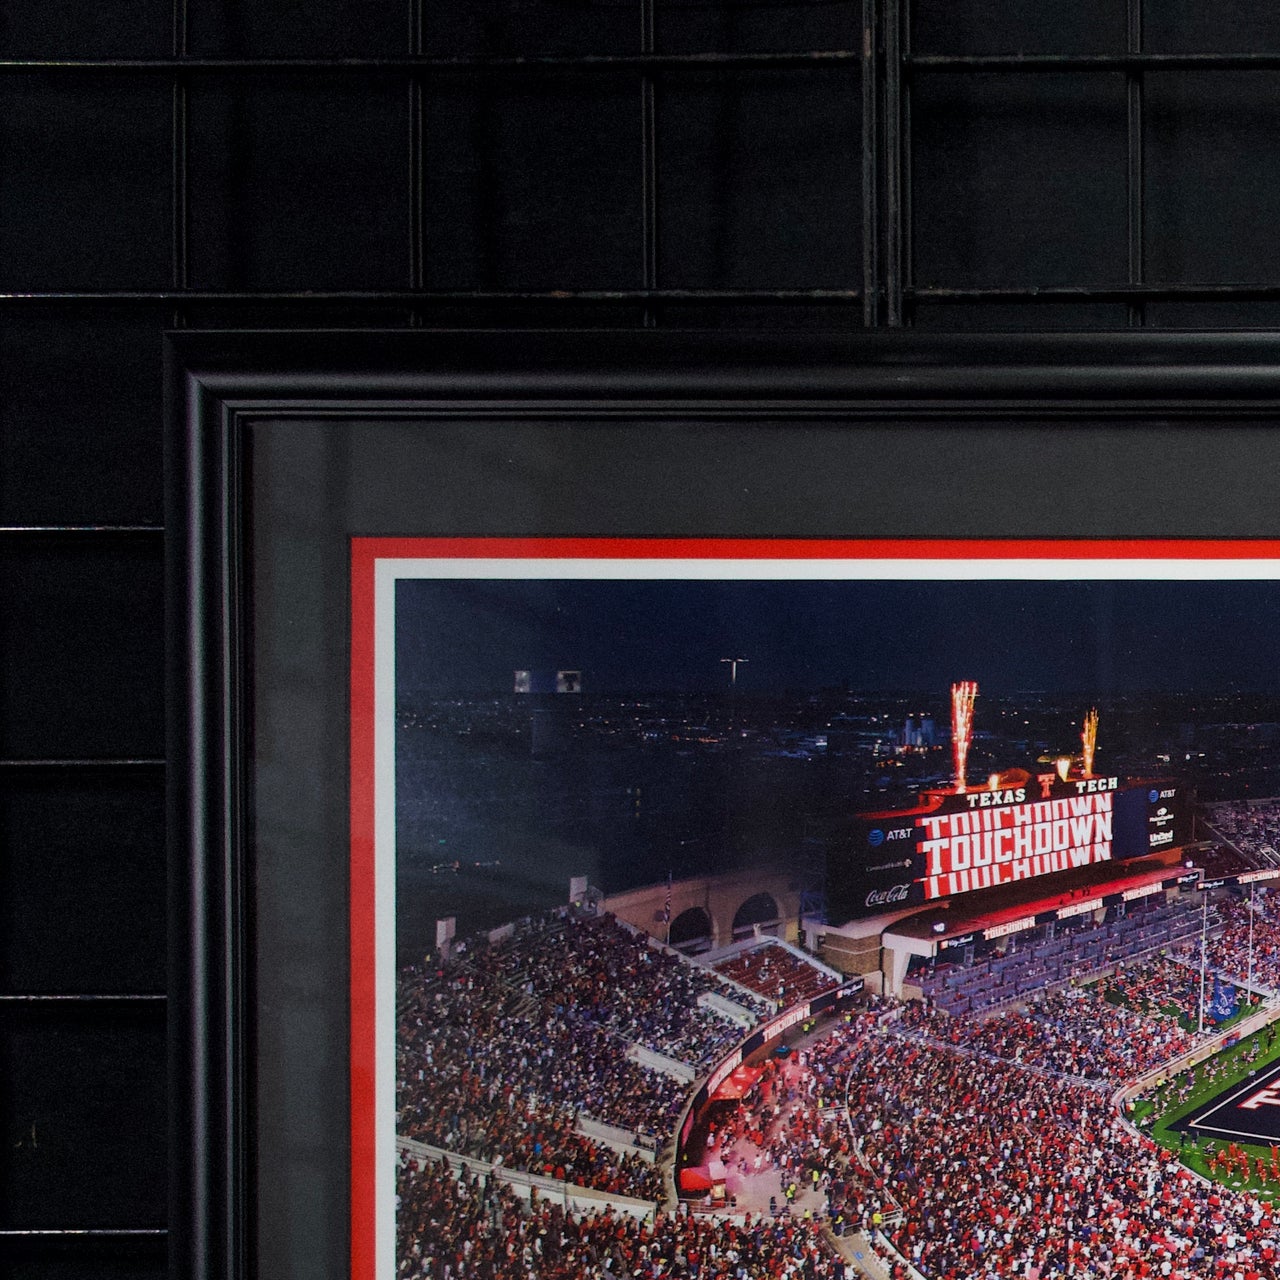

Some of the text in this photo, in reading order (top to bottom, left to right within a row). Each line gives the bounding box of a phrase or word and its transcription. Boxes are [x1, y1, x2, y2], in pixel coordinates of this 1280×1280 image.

[967, 789, 1025, 808] TEXAS
[1076, 777, 1118, 793] TECH
[887, 828, 912, 841] AT&T
[922, 811, 1113, 876] TOUCHDOWN
[983, 916, 1035, 940] TOUCHDOWN
